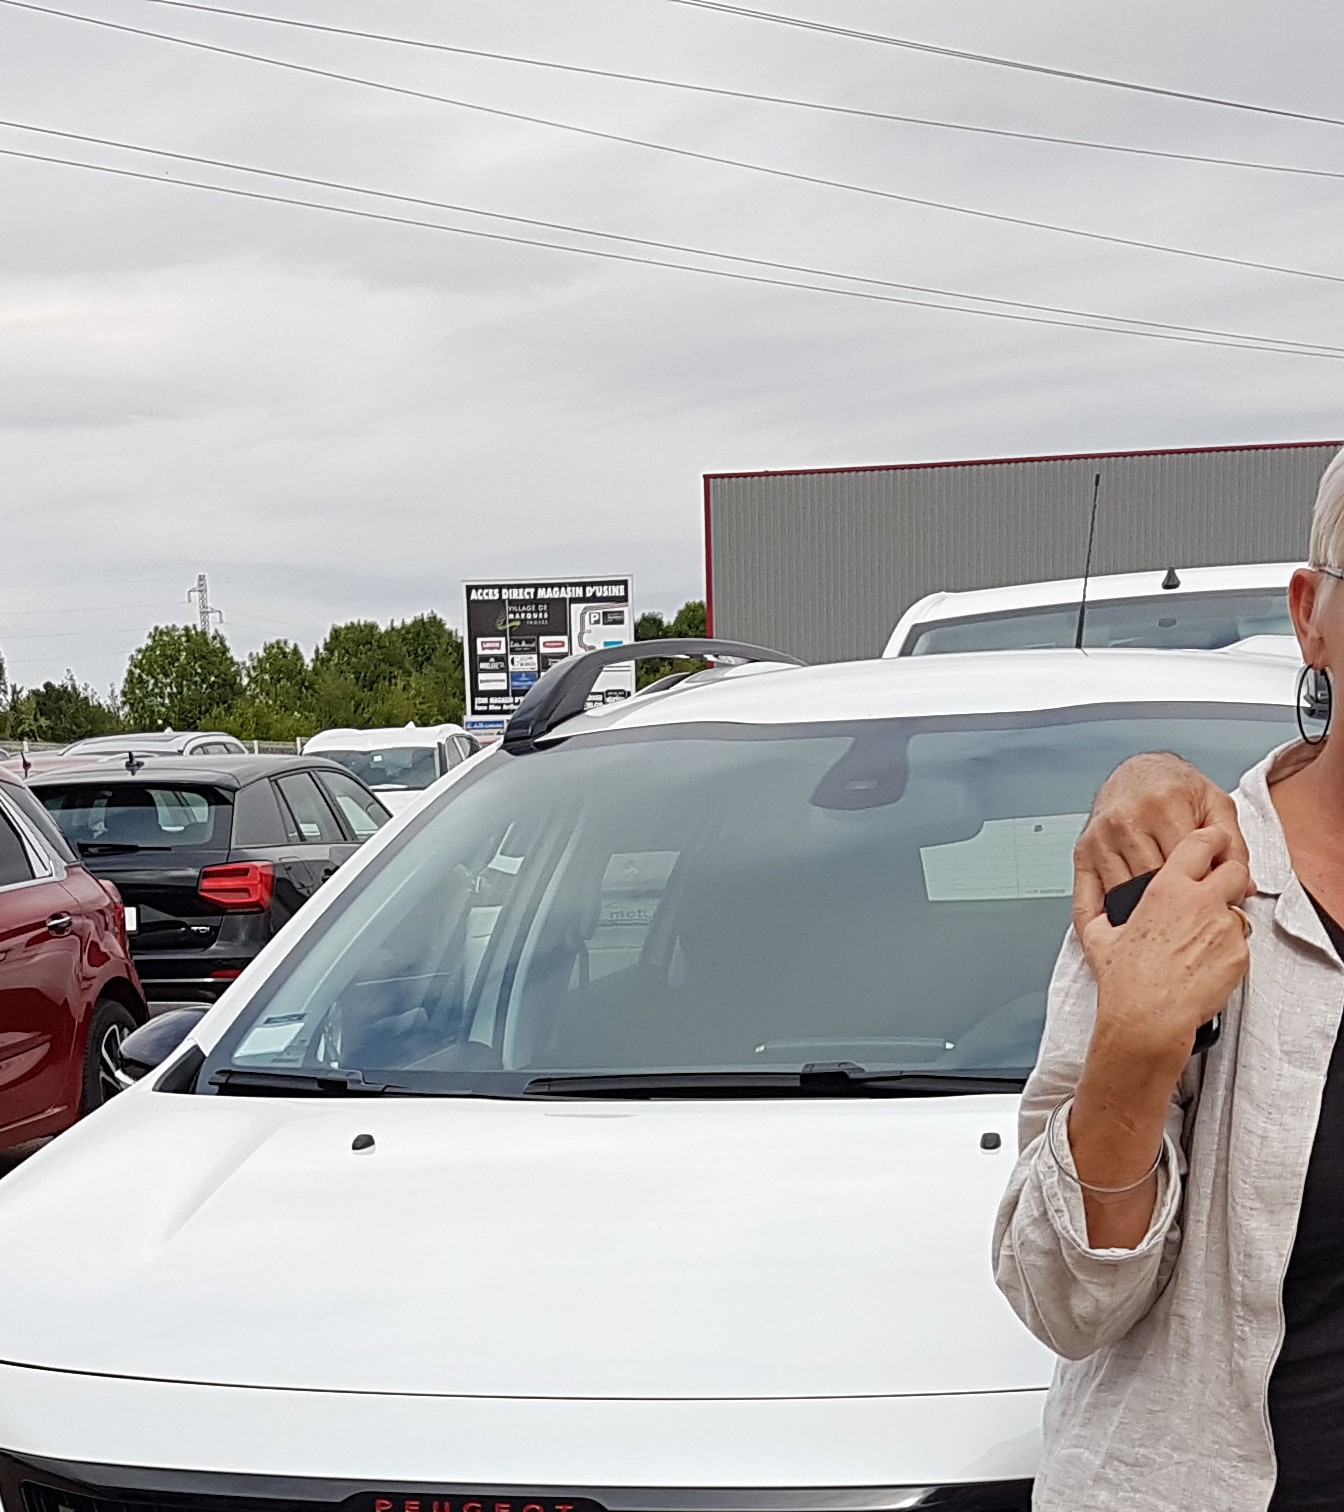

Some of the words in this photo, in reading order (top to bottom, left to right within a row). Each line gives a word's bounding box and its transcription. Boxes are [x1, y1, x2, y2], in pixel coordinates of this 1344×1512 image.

[470, 589, 499, 600] ACCES
[502, 587, 535, 599] DIRECT
[537, 586, 584, 599] MAGASIN
[586, 585, 625, 597] D'USINE
